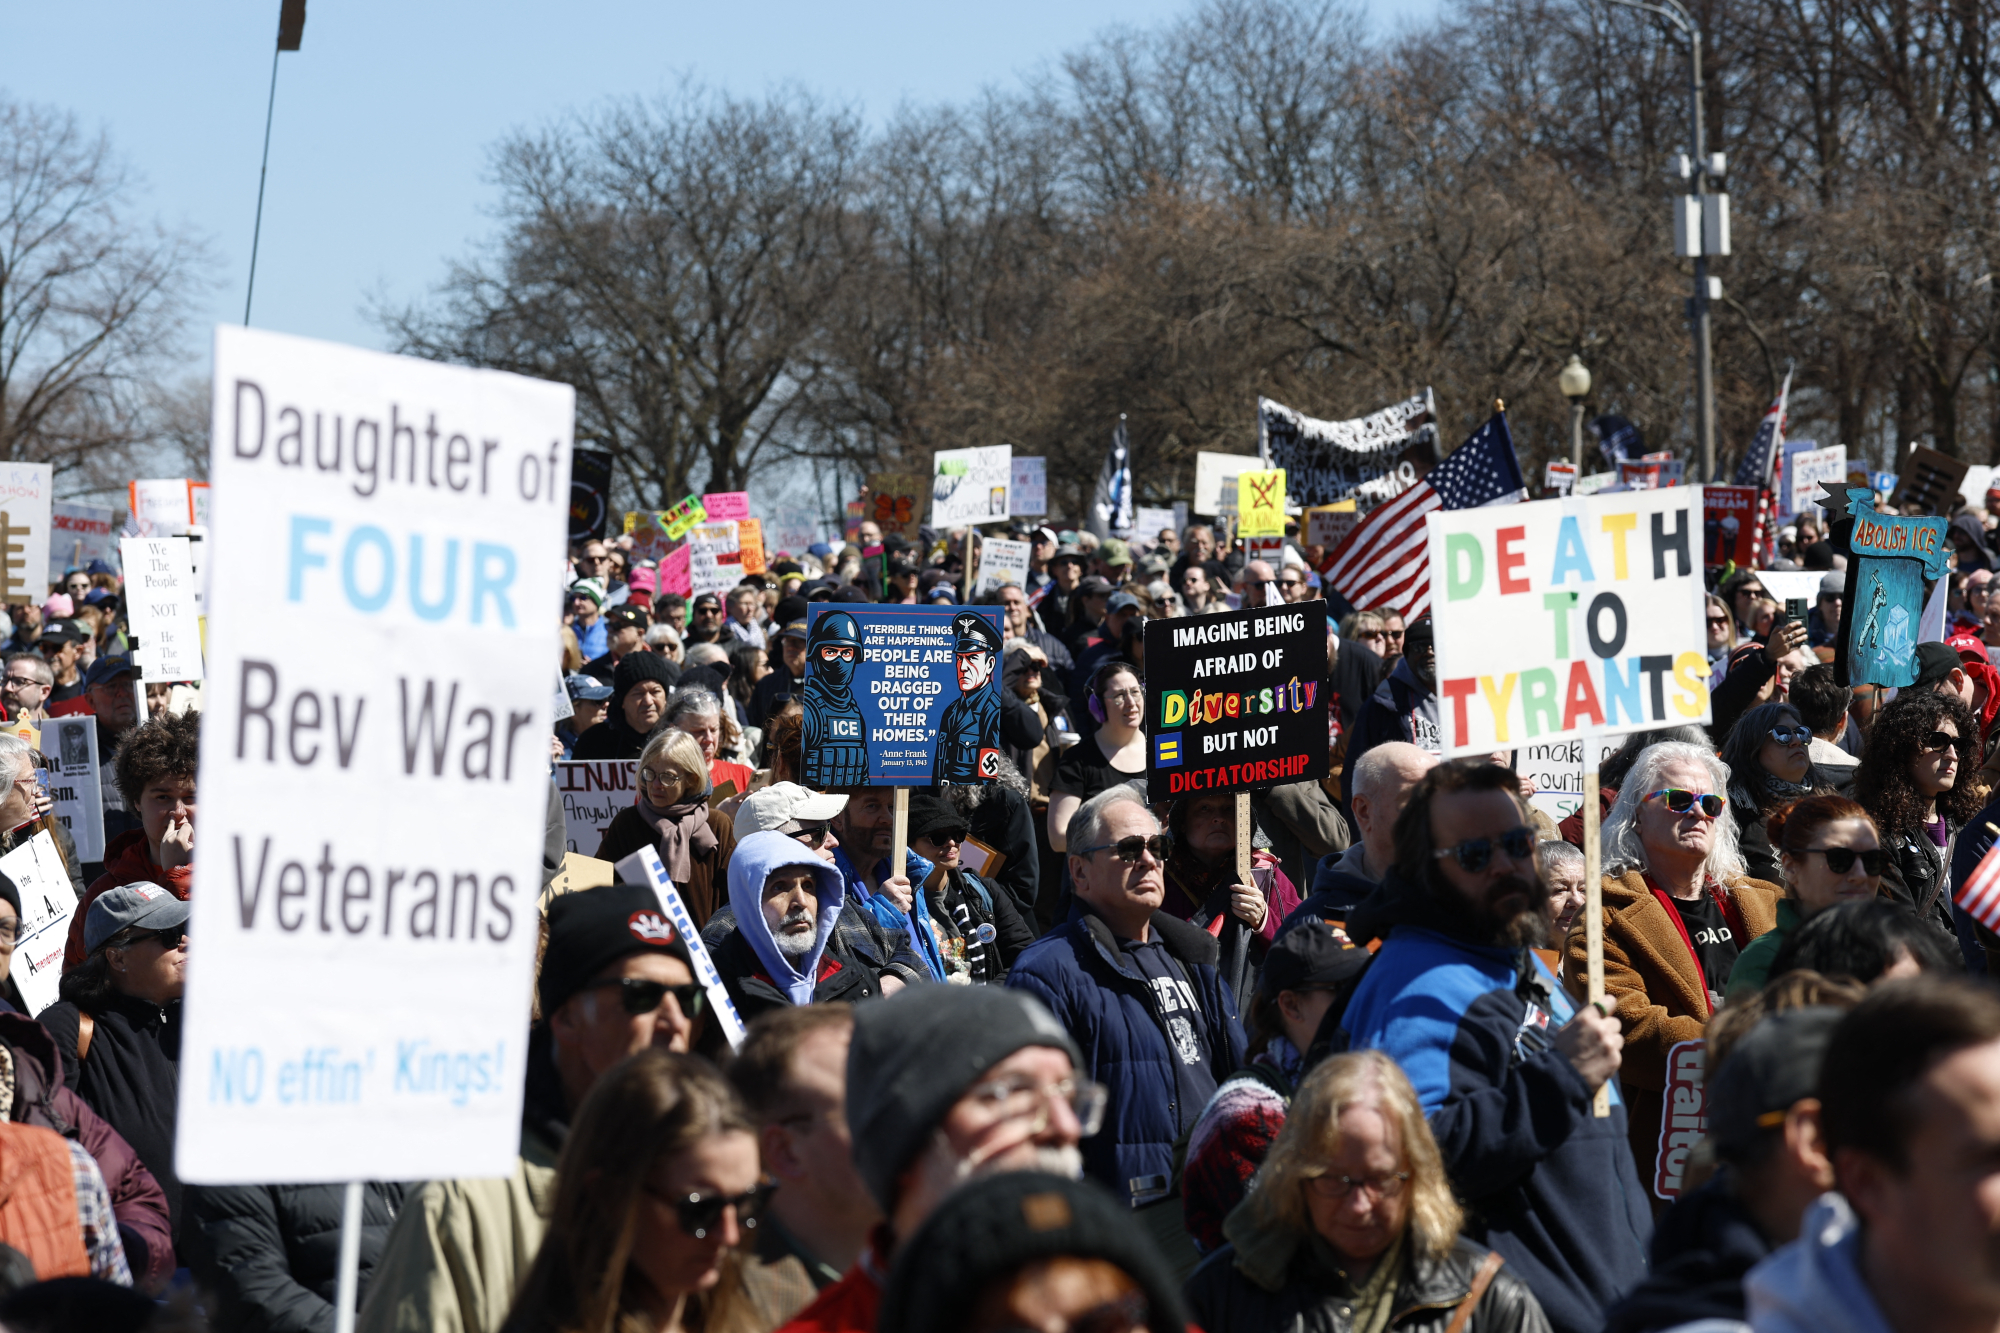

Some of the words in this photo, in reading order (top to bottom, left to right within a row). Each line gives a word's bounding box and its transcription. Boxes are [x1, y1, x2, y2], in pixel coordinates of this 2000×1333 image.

[232, 378, 499, 498] Daughter
[518, 440, 561, 503] of
[978, 450, 1000, 466] NO
[1703, 497, 1749, 510] DREAM
[1239, 512, 1253, 528] NO
[1854, 518, 1908, 551] ABOLISH
[1912, 526, 1937, 555] ICE
[149, 543, 168, 556] We
[1446, 508, 1692, 602] DEATH
[149, 559, 170, 572] The
[286, 514, 519, 629] FOUR
[145, 575, 178, 589] People
[151, 603, 178, 617] NOT
[863, 624, 916, 635] “TERRIBLE
[918, 625, 953, 635] THINGS
[1173, 620, 1249, 648] IMAGINE
[1254, 613, 1305, 638] BEING
[1543, 591, 1628, 660] TO
[161, 631, 174, 643] He
[864, 636, 885, 646] ARE
[887, 636, 952, 647] HAPPENING...
[160, 647, 178, 659] The
[863, 648, 920, 663] PEOPLE
[922, 649, 953, 664] ARE
[161, 663, 181, 676] King
[1193, 652, 1257, 679] AFRAID
[1262, 648, 1284, 670] OF
[884, 665, 930, 679] BEING
[870, 681, 942, 695] DRAGGED
[878, 697, 909, 710] OUT
[913, 697, 934, 711] OF
[1161, 676, 1318, 729] Diversity
[1442, 650, 1713, 748] TYRANTS
[234, 656, 365, 769] Rev
[396, 676, 534, 782] War
[553, 704, 572, 718] NGS
[884, 713, 927, 726] THEIR
[832, 720, 859, 736] ICE
[872, 728, 937, 743] HOMES.”
[1203, 732, 1238, 754] BUT
[1243, 725, 1279, 749] NOT
[879, 749, 903, 758] -Anne
[904, 749, 928, 758] Frank
[881, 759, 904, 767] January
[558, 762, 640, 792] INJUS
[1170, 753, 1310, 794] DICTATORSHIP
[563, 793, 627, 824] Anywh
[232, 833, 517, 943] Veterans
[1694, 926, 1732, 946] DAD
[208, 1047, 265, 1107] NO
[276, 1045, 376, 1107] effin'
[394, 1039, 506, 1109] Kings!
